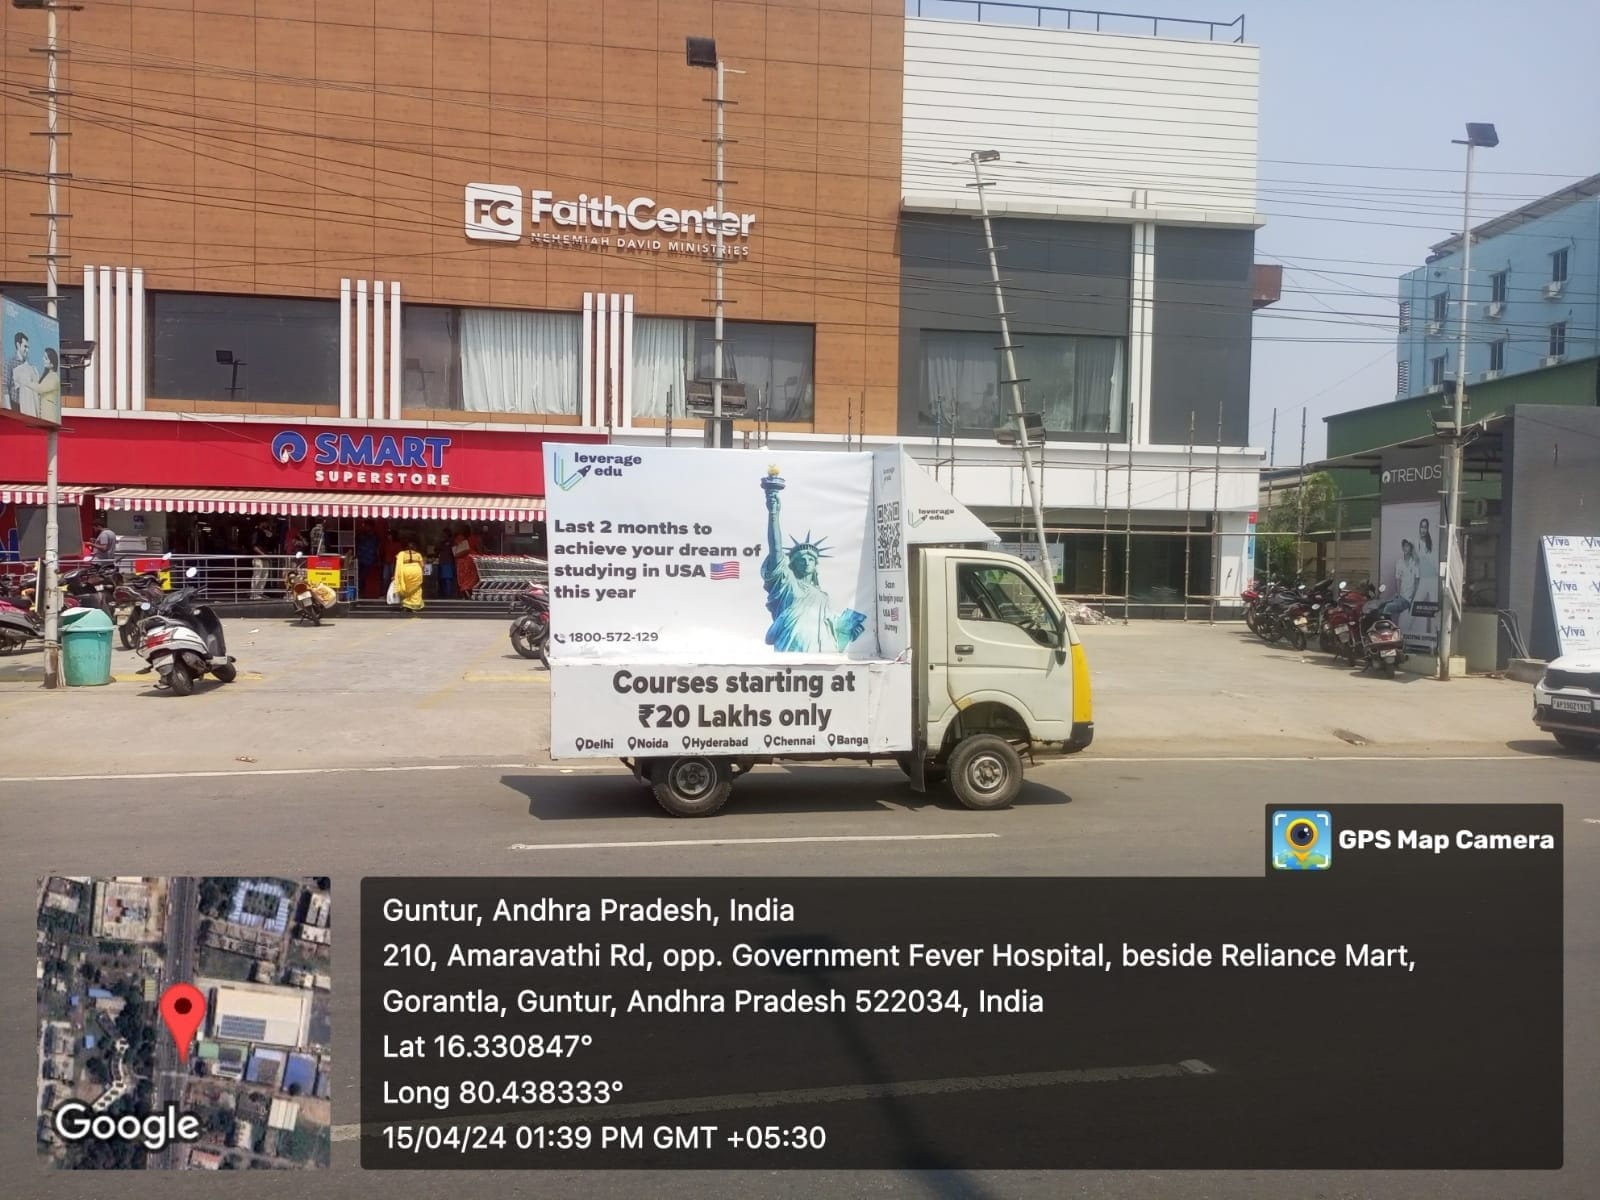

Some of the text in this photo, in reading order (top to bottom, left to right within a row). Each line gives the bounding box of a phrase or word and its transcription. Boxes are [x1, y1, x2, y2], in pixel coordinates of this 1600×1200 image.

[531, 189, 756, 237] FaithCenter
[531, 231, 750, 256] NEHEMIAH DAVID MINISTRIES
[314, 432, 452, 468] SMART
[574, 452, 642, 467] leverage
[314, 470, 450, 486] SUPERSTORE
[594, 465, 623, 477] edu
[1390, 465, 1442, 483] TRENDS
[918, 508, 955, 516] leverage
[554, 519, 712, 535] Last 2 months to
[554, 541, 761, 558] achieve your dream of
[554, 563, 706, 580] studying in USA
[554, 584, 637, 602] this year
[570, 632, 659, 643] 1800-572-129
[613, 668, 856, 698] Courses starting at
[638, 703, 833, 731] ₹20 Lakhs only
[585, 738, 614, 750] Delhi
[637, 737, 669, 749] Noida
[691, 736, 749, 750] Hyderabad
[773, 734, 816, 747] Chennai
